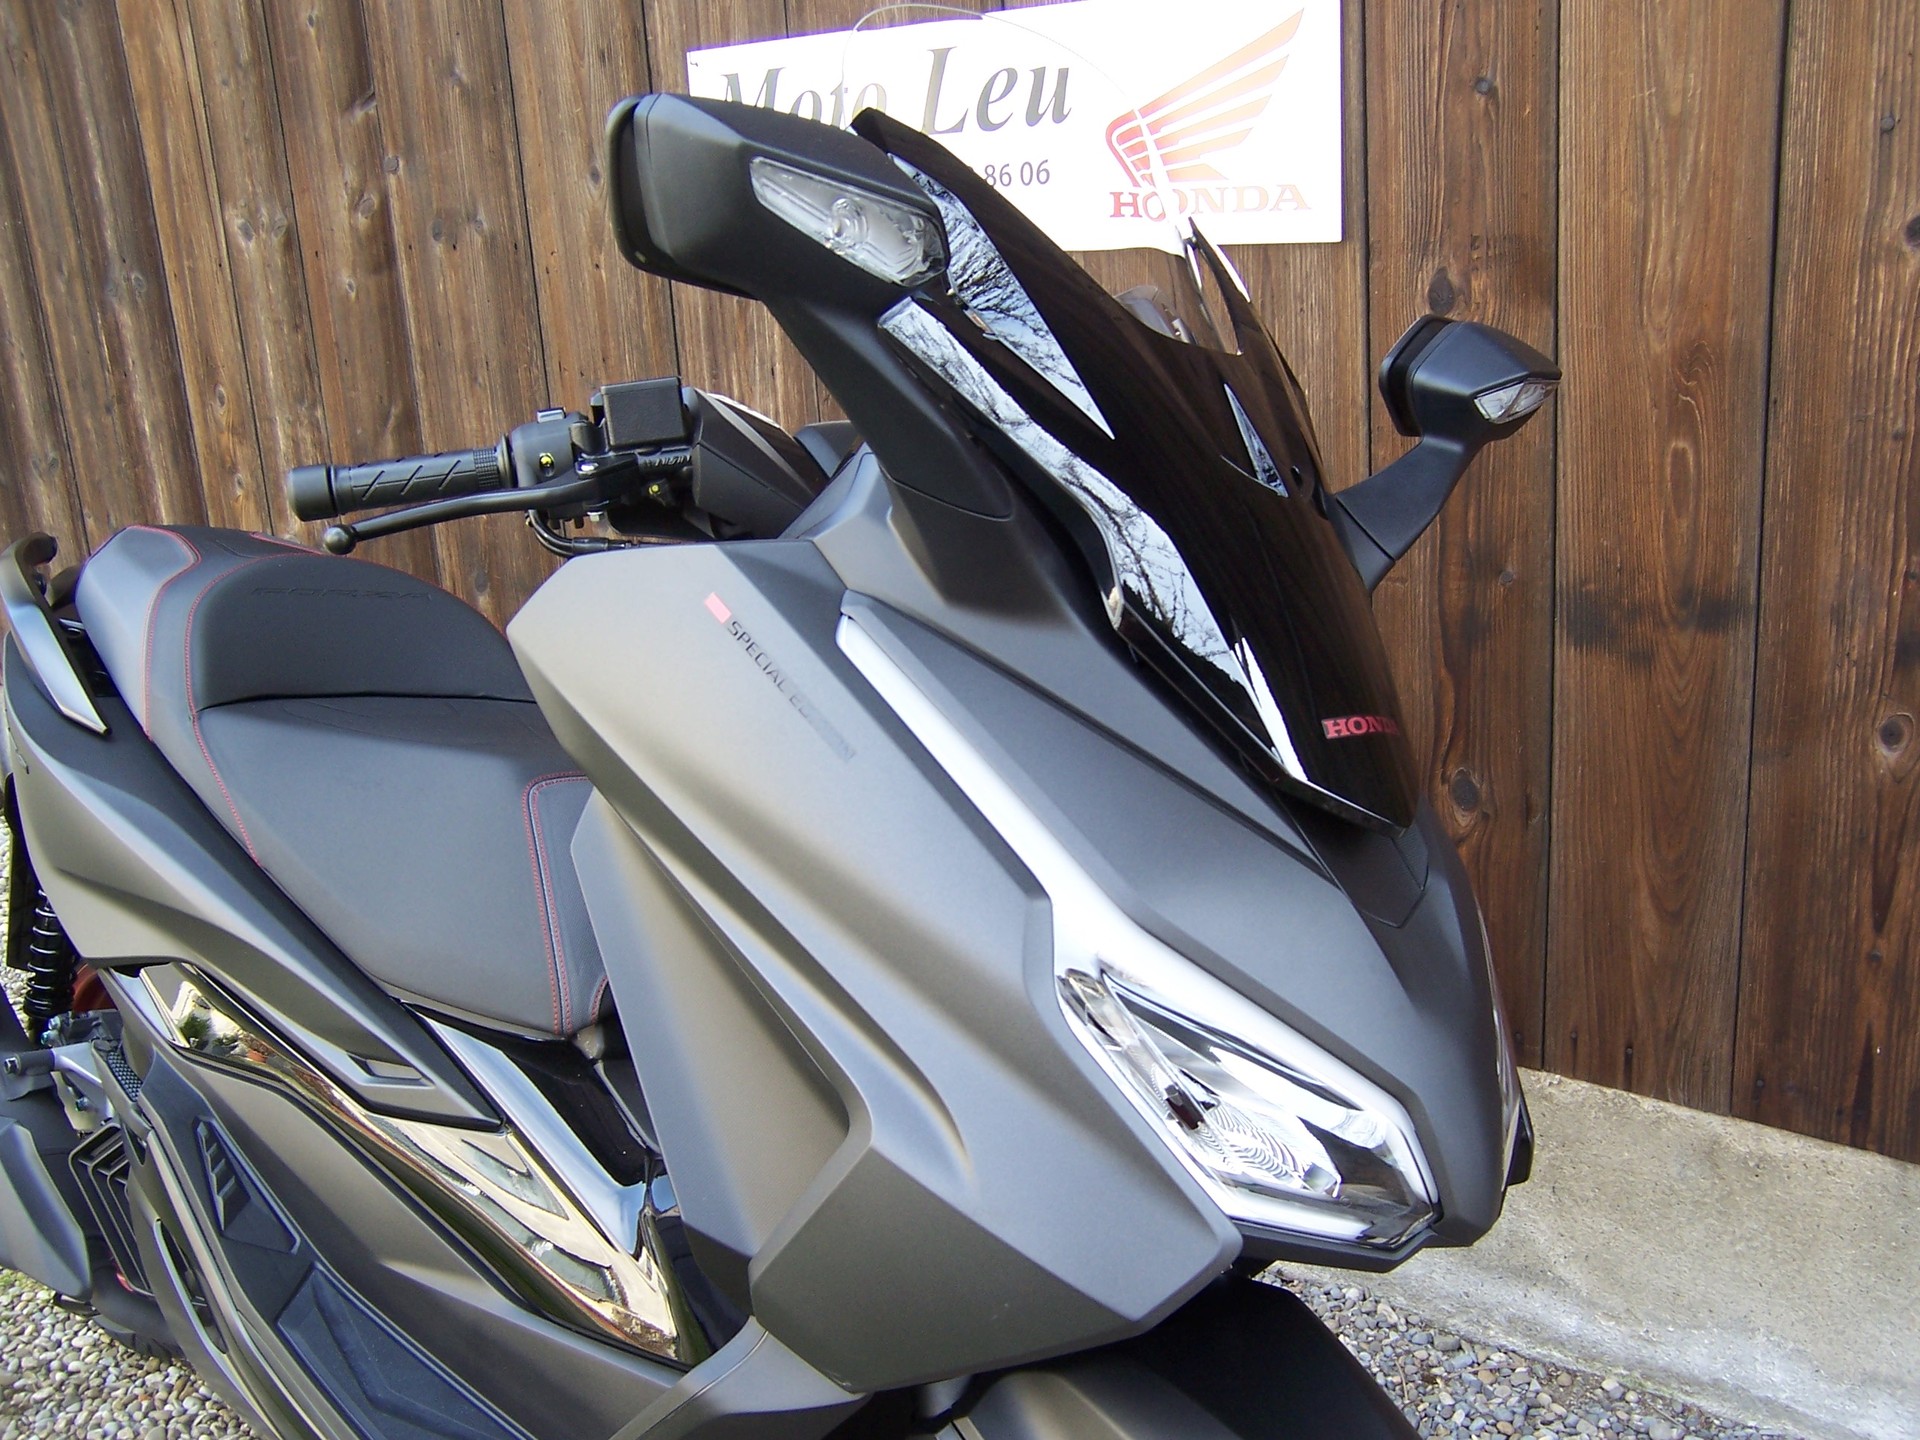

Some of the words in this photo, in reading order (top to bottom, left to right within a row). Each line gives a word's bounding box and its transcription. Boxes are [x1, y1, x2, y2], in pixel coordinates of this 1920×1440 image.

[921, 46, 1072, 135] Leu
[1020, 159, 1050, 186] 06
[1109, 183, 1312, 222] HONDA
[727, 620, 788, 693] SPECIAL
